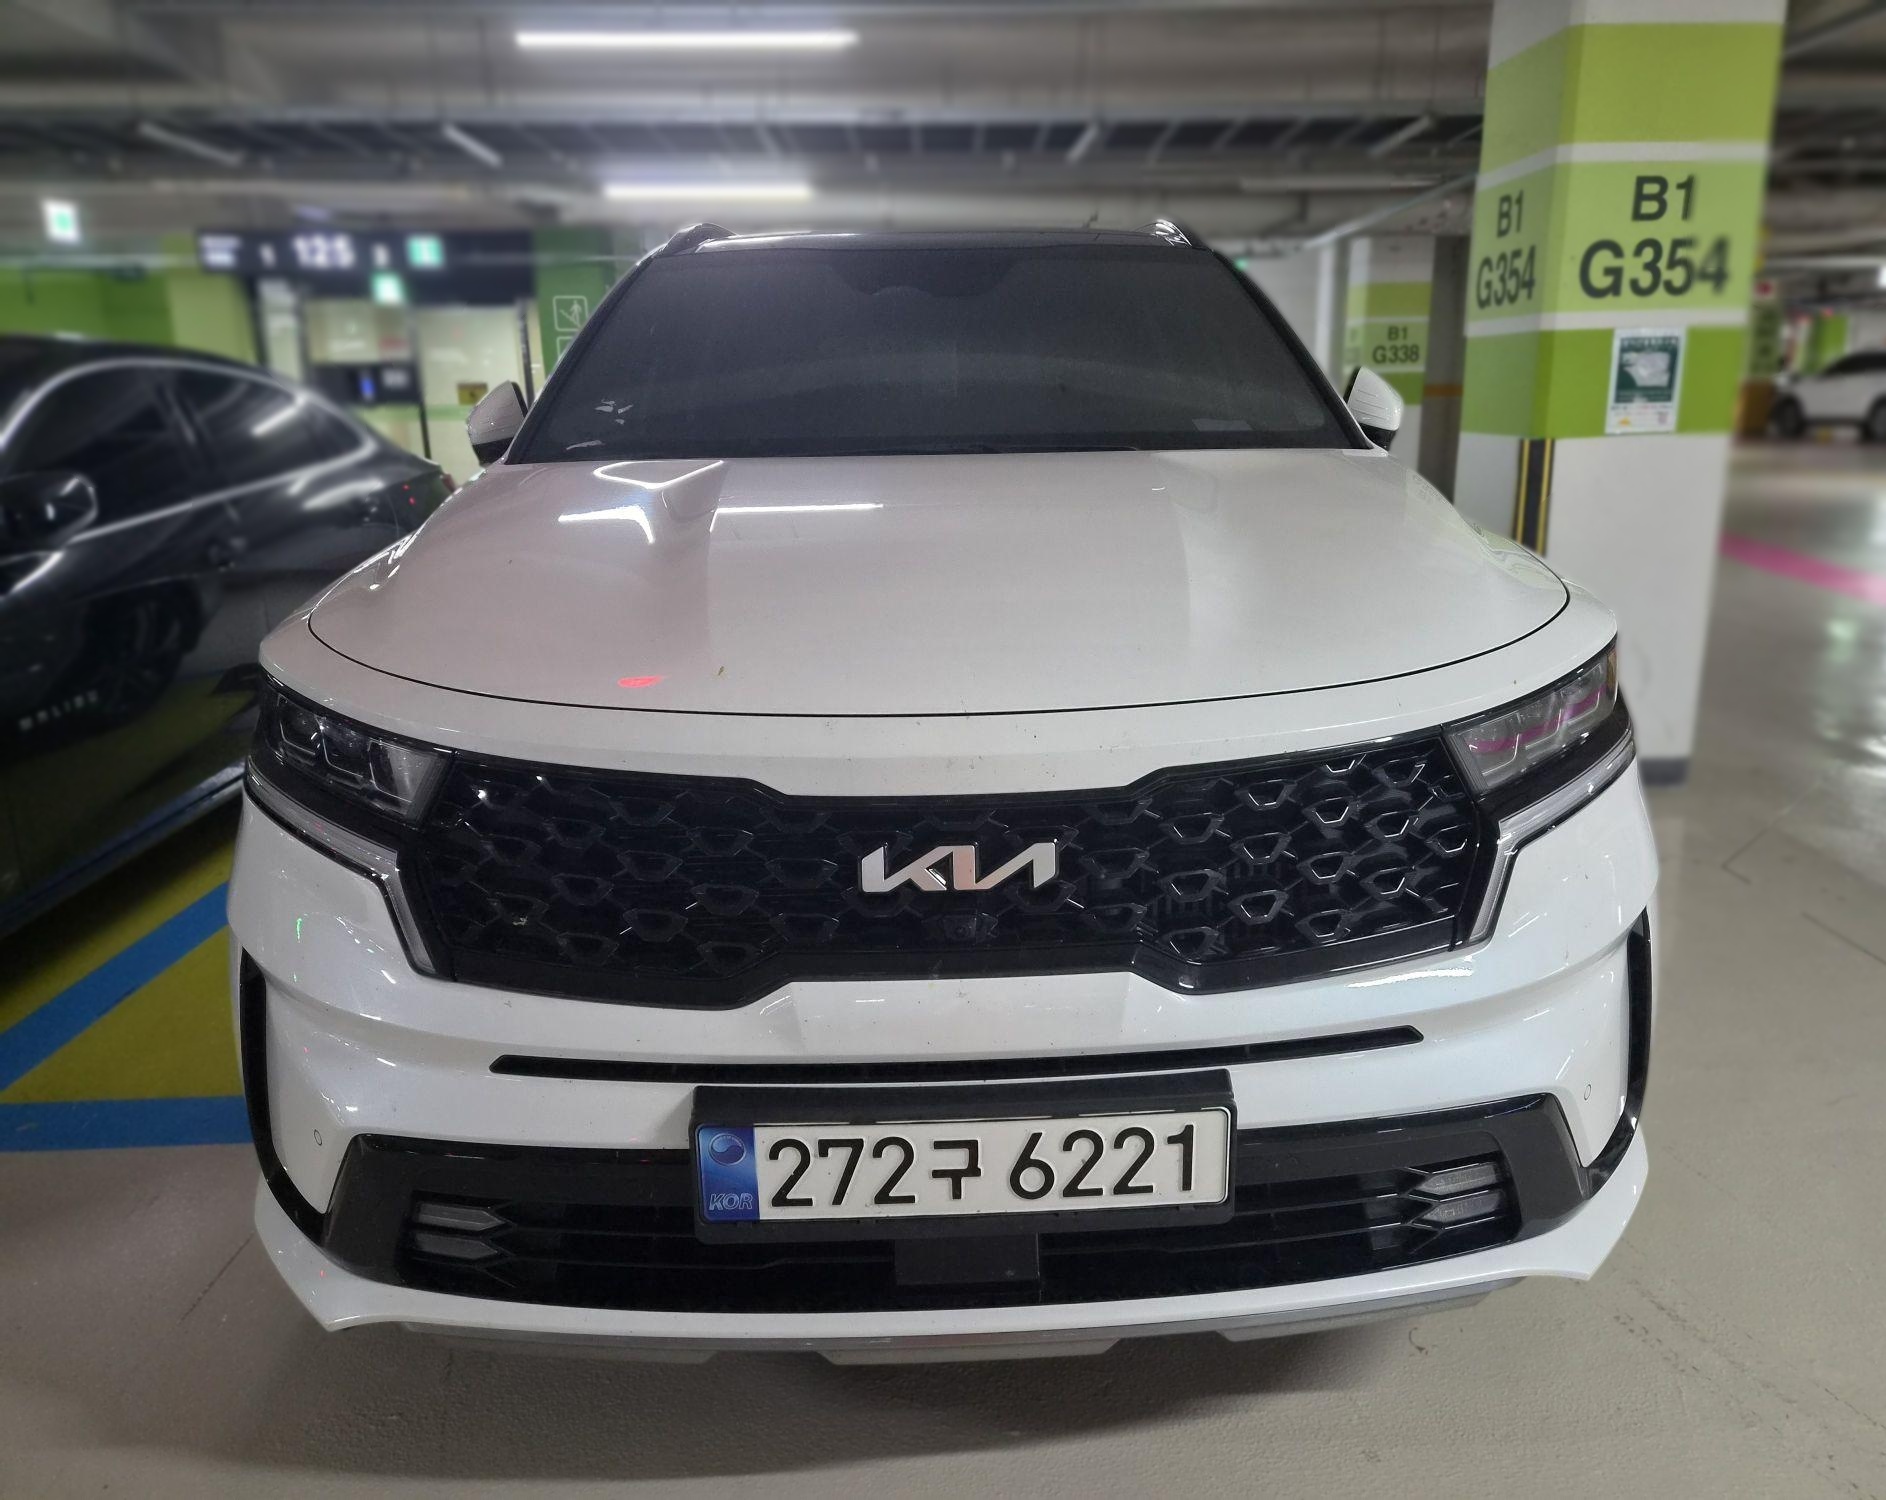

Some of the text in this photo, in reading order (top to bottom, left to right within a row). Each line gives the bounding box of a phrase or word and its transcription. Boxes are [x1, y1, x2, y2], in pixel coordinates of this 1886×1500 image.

[1496, 189, 1524, 239] B1
[1631, 174, 1697, 222] B1
[1476, 243, 1537, 310] G354
[1578, 235, 1730, 299] G354
[1372, 343, 1420, 365] G338
[1386, 325, 1408, 342] B1
[861, 841, 1056, 893] KIA
[768, 1124, 1194, 1208] 272구 6221
[707, 1192, 754, 1211] KOR
